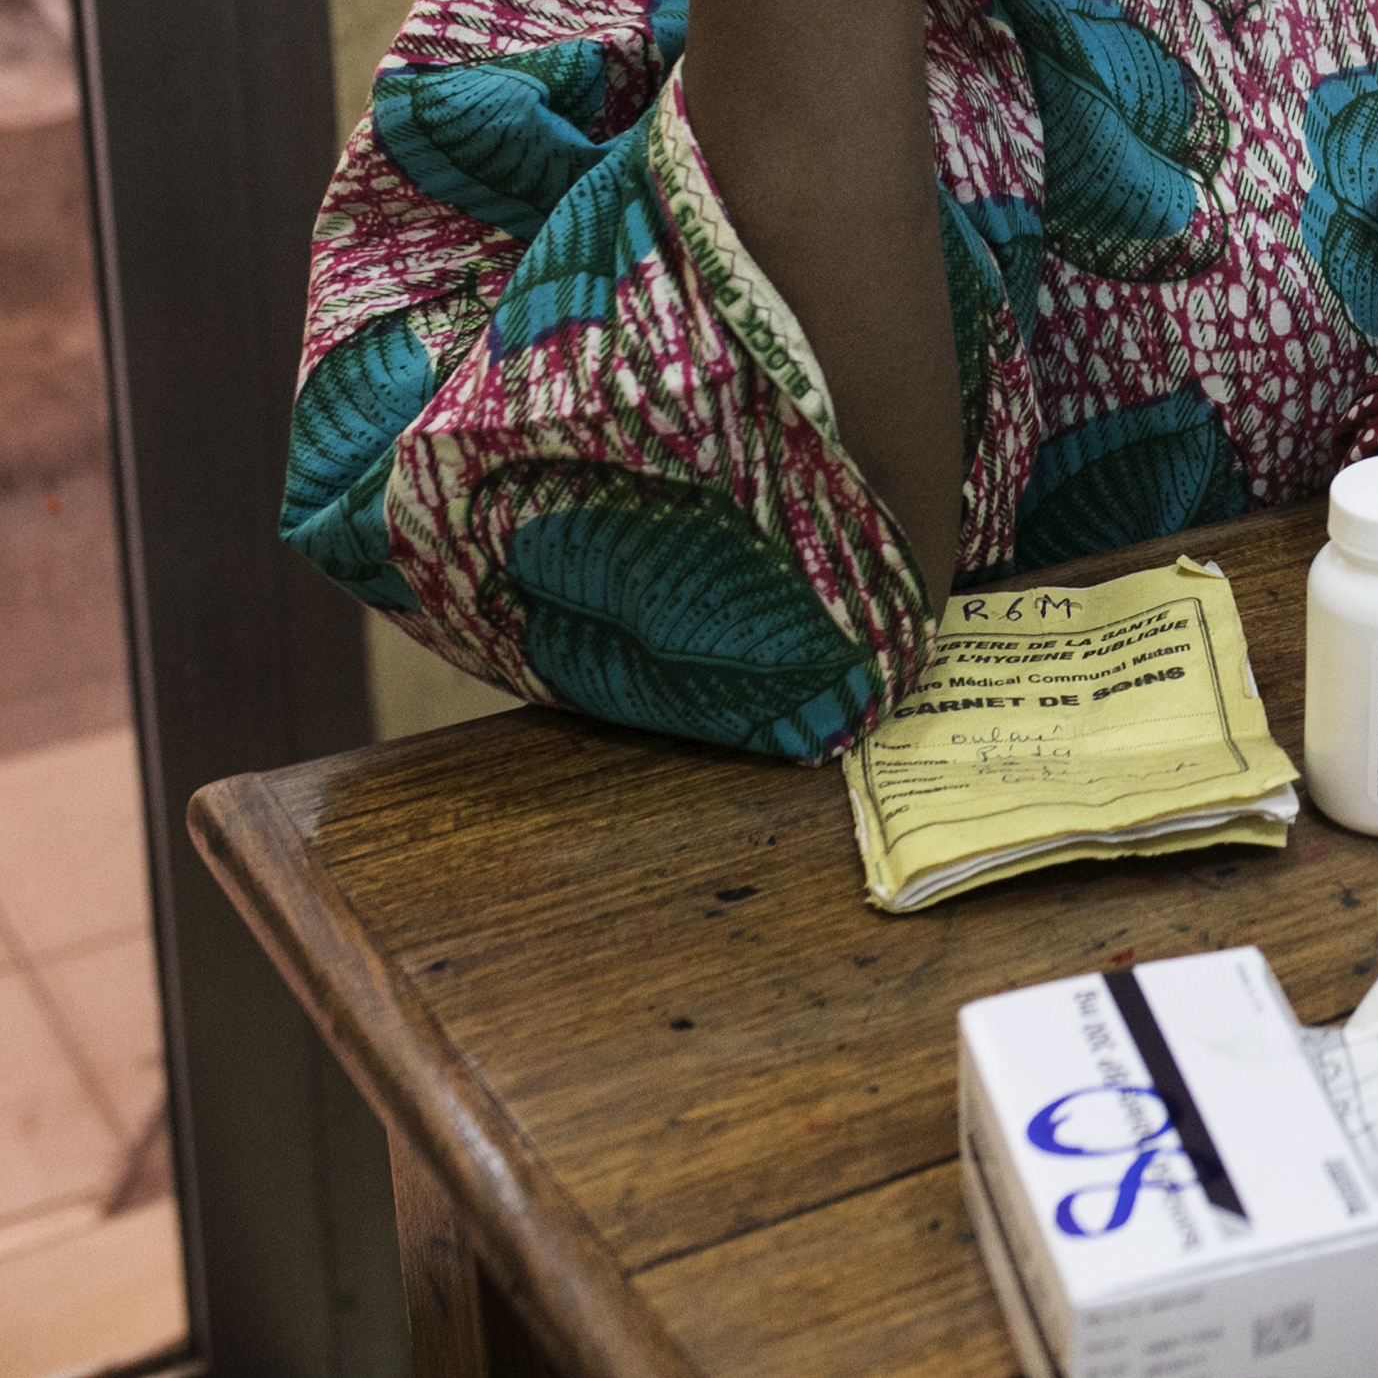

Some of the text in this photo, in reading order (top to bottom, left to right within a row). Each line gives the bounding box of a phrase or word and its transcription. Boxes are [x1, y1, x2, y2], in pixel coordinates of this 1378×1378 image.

[933, 619, 1189, 667] E L'HYGIENE PUBLIQUE
[1027, 640, 1057, 650] DE
[1065, 638, 1092, 647] LA
[1101, 610, 1170, 642] SANTE
[949, 673, 1021, 688] Médical
[1028, 660, 1127, 684] Communal
[1132, 641, 1191, 666] Matam
[894, 666, 1186, 718] CARNET DE SOINS
